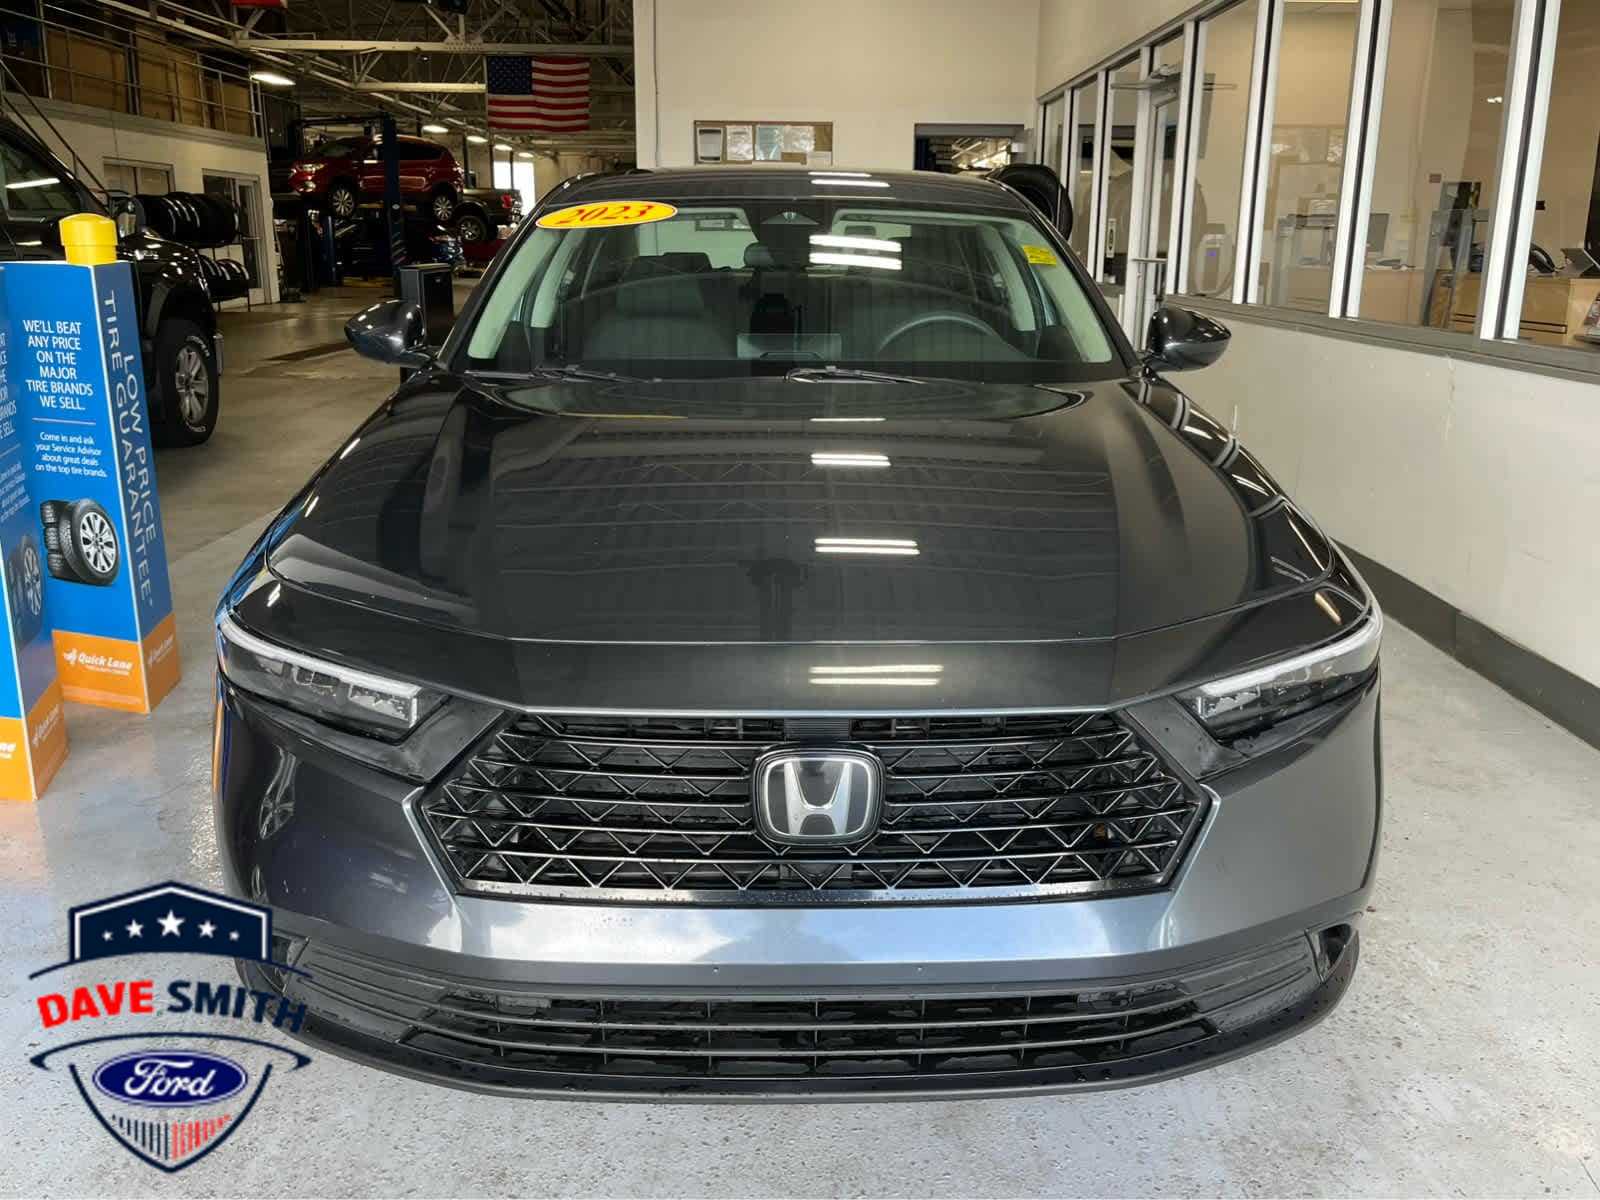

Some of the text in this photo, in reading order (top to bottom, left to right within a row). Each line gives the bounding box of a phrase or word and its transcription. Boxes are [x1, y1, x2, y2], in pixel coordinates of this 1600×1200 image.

[554, 205, 654, 225] 2023
[23, 320, 82, 334] WE'LL BEAT
[28, 335, 82, 350] ANY PRICE
[36, 351, 77, 365] ON THE
[39, 366, 77, 380] MAJOR
[25, 379, 49, 393] TIRE
[50, 382, 94, 396] BRANDS
[40, 395, 86, 410] WE SELL.
[40, 431, 60, 441] Come
[104, 290, 152, 600] TIRE GUARANTEE
[123, 353, 156, 544] LOW PRICE
[41, 453, 62, 463] about
[35, 463, 45, 471] on
[45, 463, 57, 473] the
[78, 651, 106, 668] Quick
[106, 656, 133, 670] Lane
